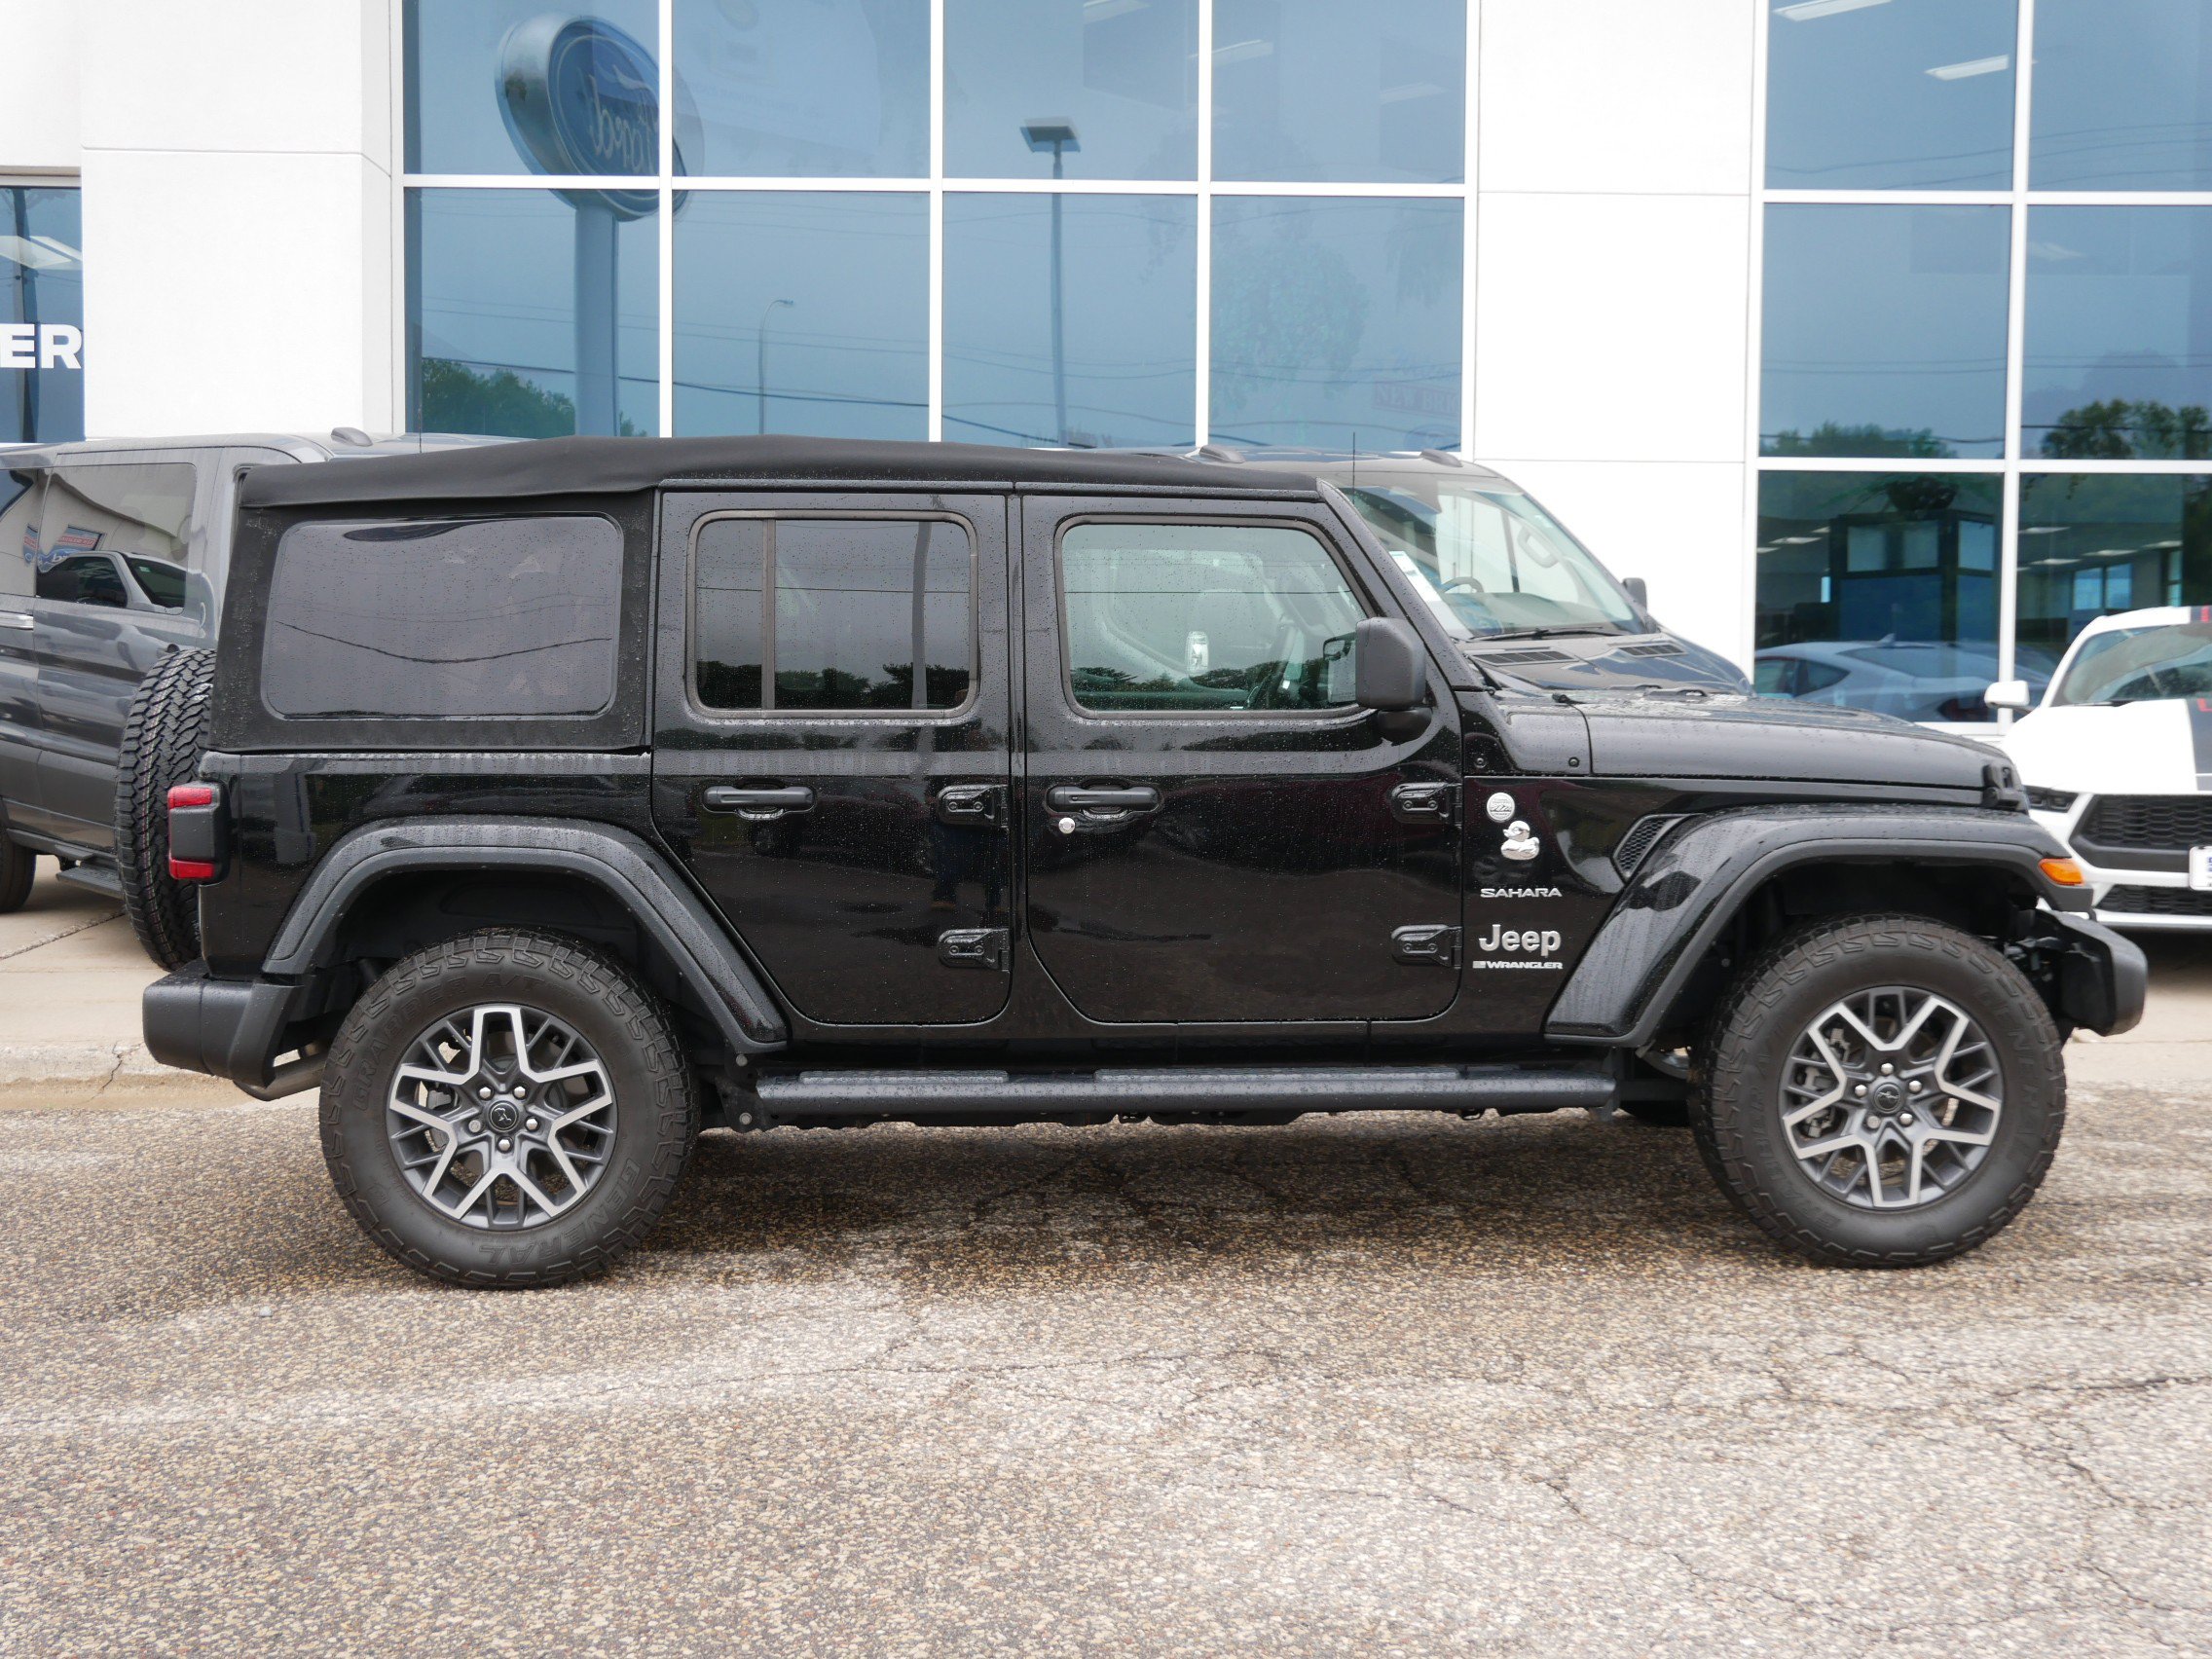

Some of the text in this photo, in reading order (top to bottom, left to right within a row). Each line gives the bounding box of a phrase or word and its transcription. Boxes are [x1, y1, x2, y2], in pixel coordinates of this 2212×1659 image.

[0, 323, 82, 369] ER
[1480, 888, 1563, 898] SAHARA
[1479, 924, 1562, 957] Jeep
[1486, 960, 1564, 970] WRANGLER
[478, 1157, 643, 1266] GENERAL
